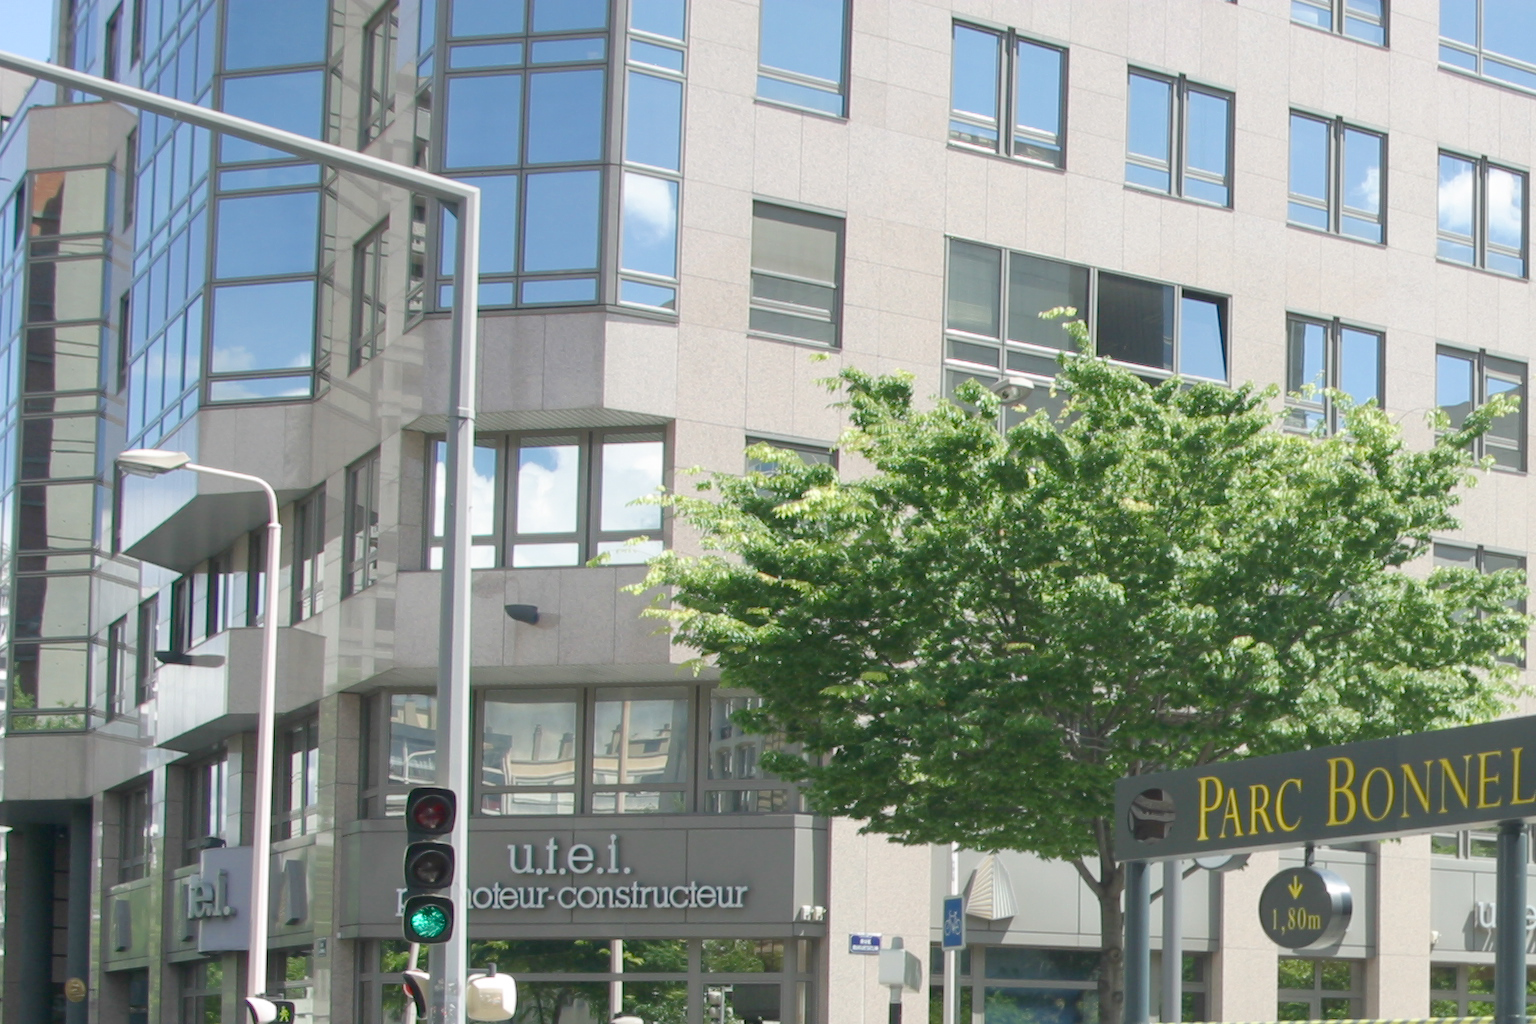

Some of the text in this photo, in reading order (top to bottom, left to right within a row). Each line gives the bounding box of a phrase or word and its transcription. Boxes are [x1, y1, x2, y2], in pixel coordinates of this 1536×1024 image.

[1196, 775, 1303, 842] PARC
[507, 833, 632, 876] u.t.e.i.
[1273, 907, 1322, 936] 1,80m
